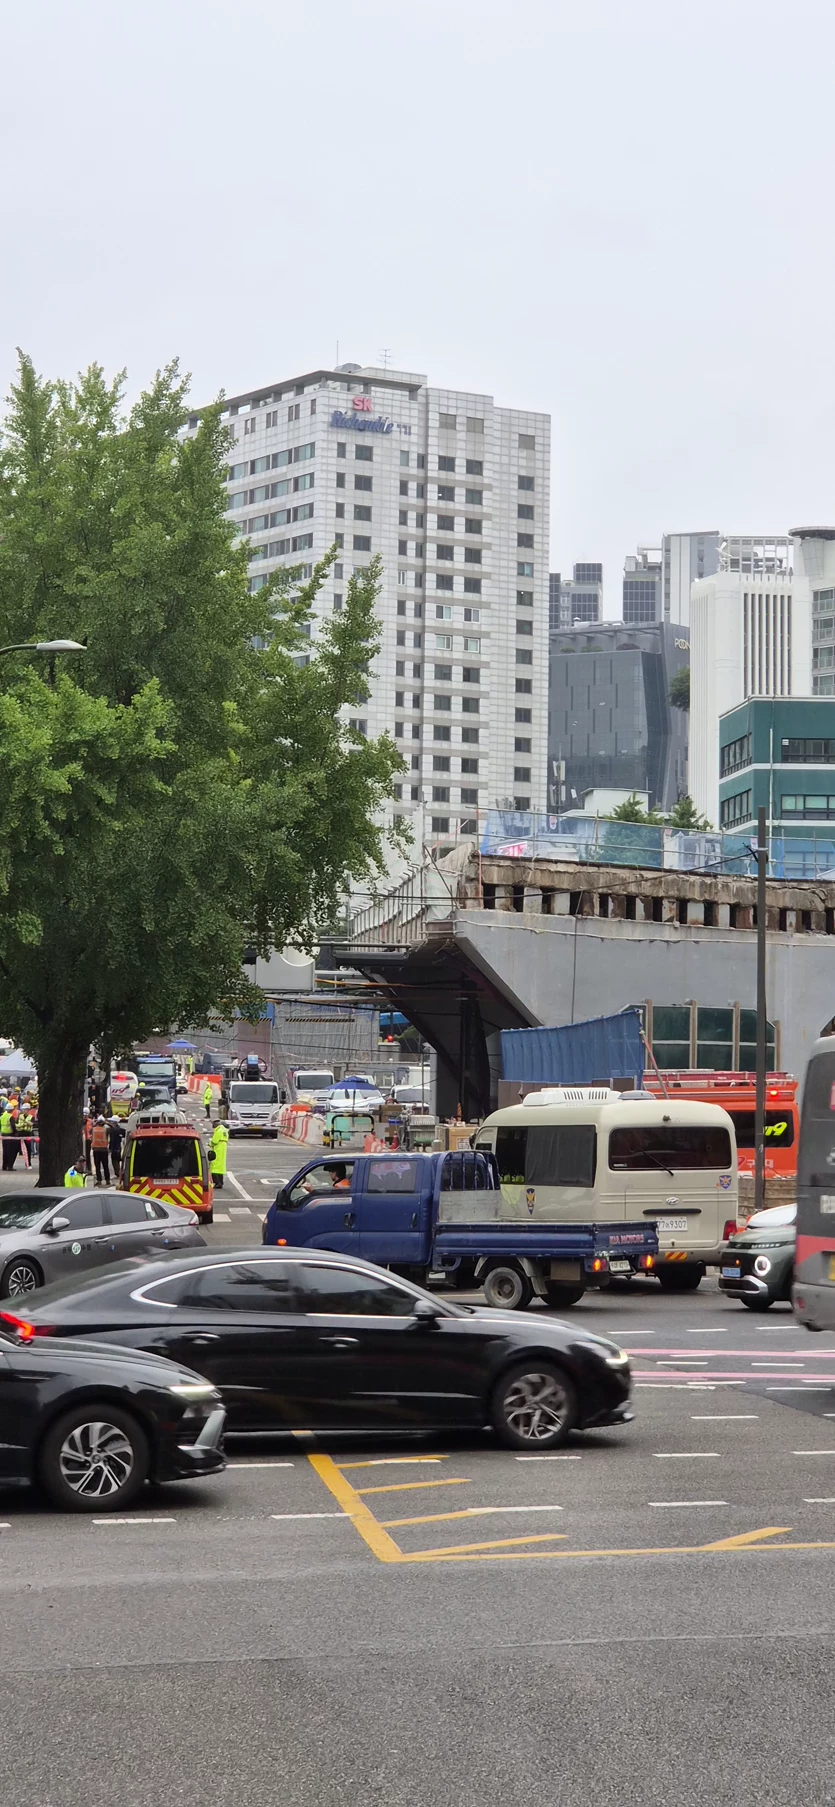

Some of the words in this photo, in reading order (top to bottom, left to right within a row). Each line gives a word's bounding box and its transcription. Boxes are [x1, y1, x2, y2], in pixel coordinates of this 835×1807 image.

[352, 396, 373, 412] SK
[609, 1235, 620, 1245] KIA
[620, 1233, 644, 1244] MOTORS
